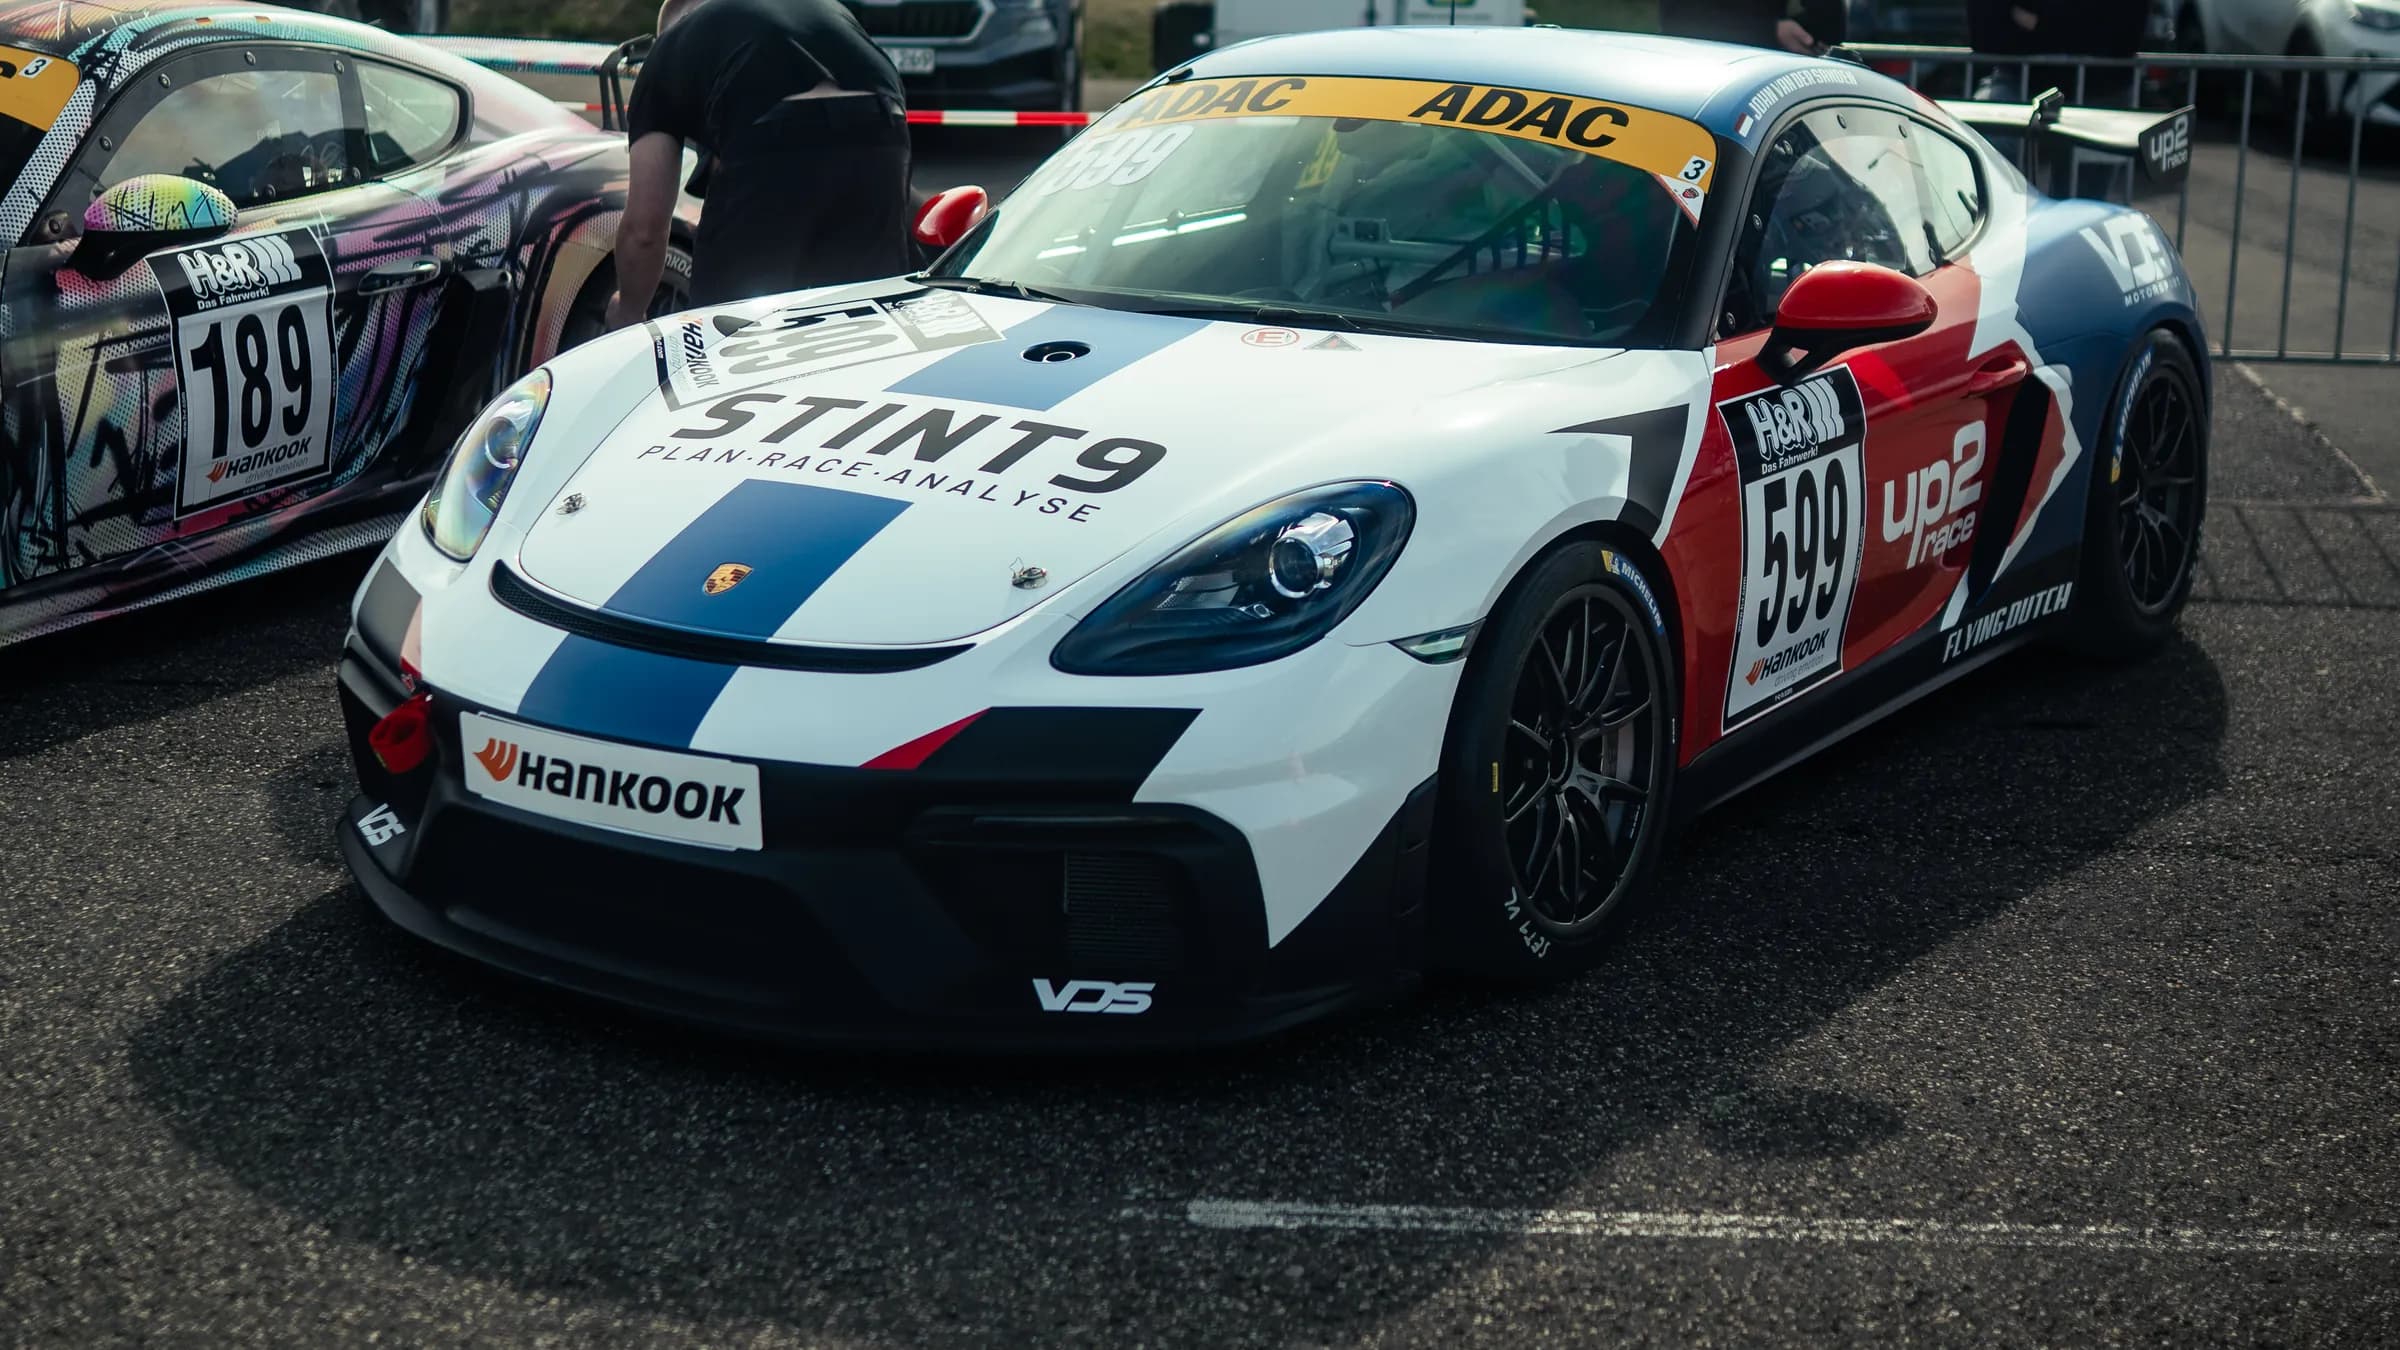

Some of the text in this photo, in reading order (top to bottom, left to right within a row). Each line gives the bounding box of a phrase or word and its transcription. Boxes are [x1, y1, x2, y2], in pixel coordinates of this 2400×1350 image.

[24, 58, 47, 77] 3
[1748, 68, 1859, 121] JOHN VAN DER SANDEN
[1115, 77, 1630, 148] ADAC ADAC
[2151, 114, 2189, 173] up2
[1040, 123, 1196, 198] 599
[1684, 159, 1706, 180] 3
[177, 242, 267, 299] H&R
[2079, 213, 2173, 294] VDS
[197, 286, 270, 311] Das Fahrwerk!
[190, 303, 313, 460] 189
[669, 392, 1168, 494] STINT9
[1745, 387, 1818, 461] H&R
[1761, 445, 1819, 475] Das Fahrwerk!
[1882, 419, 1987, 570] up2
[1757, 458, 1849, 648] 599
[1919, 511, 1976, 564] race
[1621, 561, 1662, 627] MICHELIN
[1942, 581, 2073, 664] FLYING DUTCH
[357, 802, 407, 847] VDS
[1032, 977, 1157, 1015] VDS
